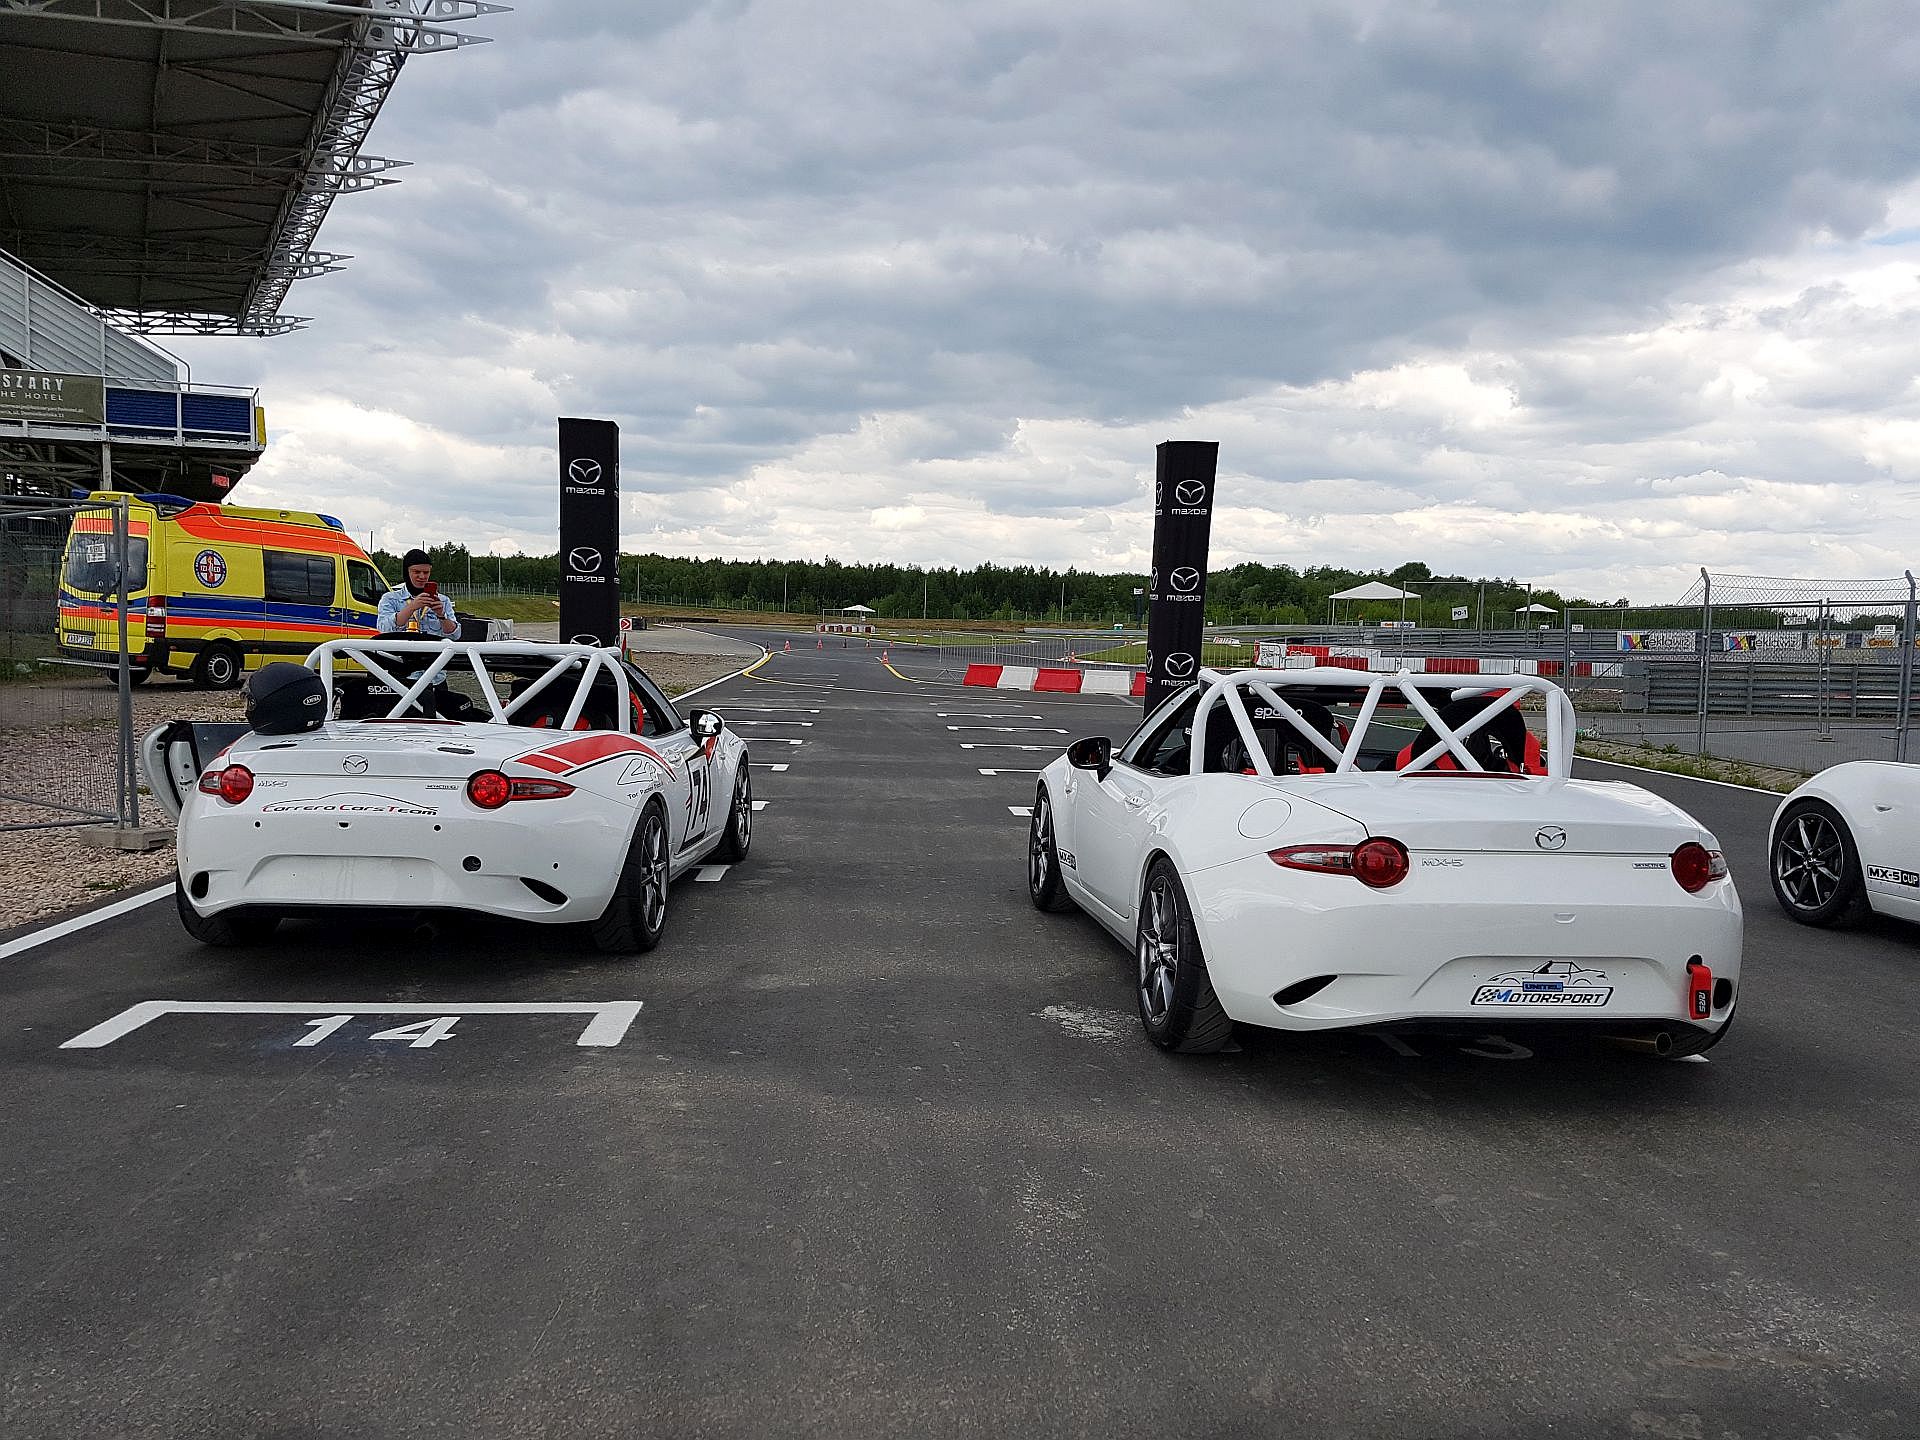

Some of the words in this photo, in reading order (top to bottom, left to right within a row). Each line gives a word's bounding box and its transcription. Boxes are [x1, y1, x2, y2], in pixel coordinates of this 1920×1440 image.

[2, 374, 64, 391] SZARY
[24, 392, 64, 402] HOTEL
[565, 486, 606, 496] mazda
[1171, 508, 1208, 516] mazda
[566, 575, 606, 583] mazda
[1166, 594, 1201, 602] mazda
[1421, 858, 1464, 867] MX-5
[1869, 867, 1900, 881] MX-5
[1902, 873, 1918, 885] CUP
[291, 1014, 461, 1047] 14
